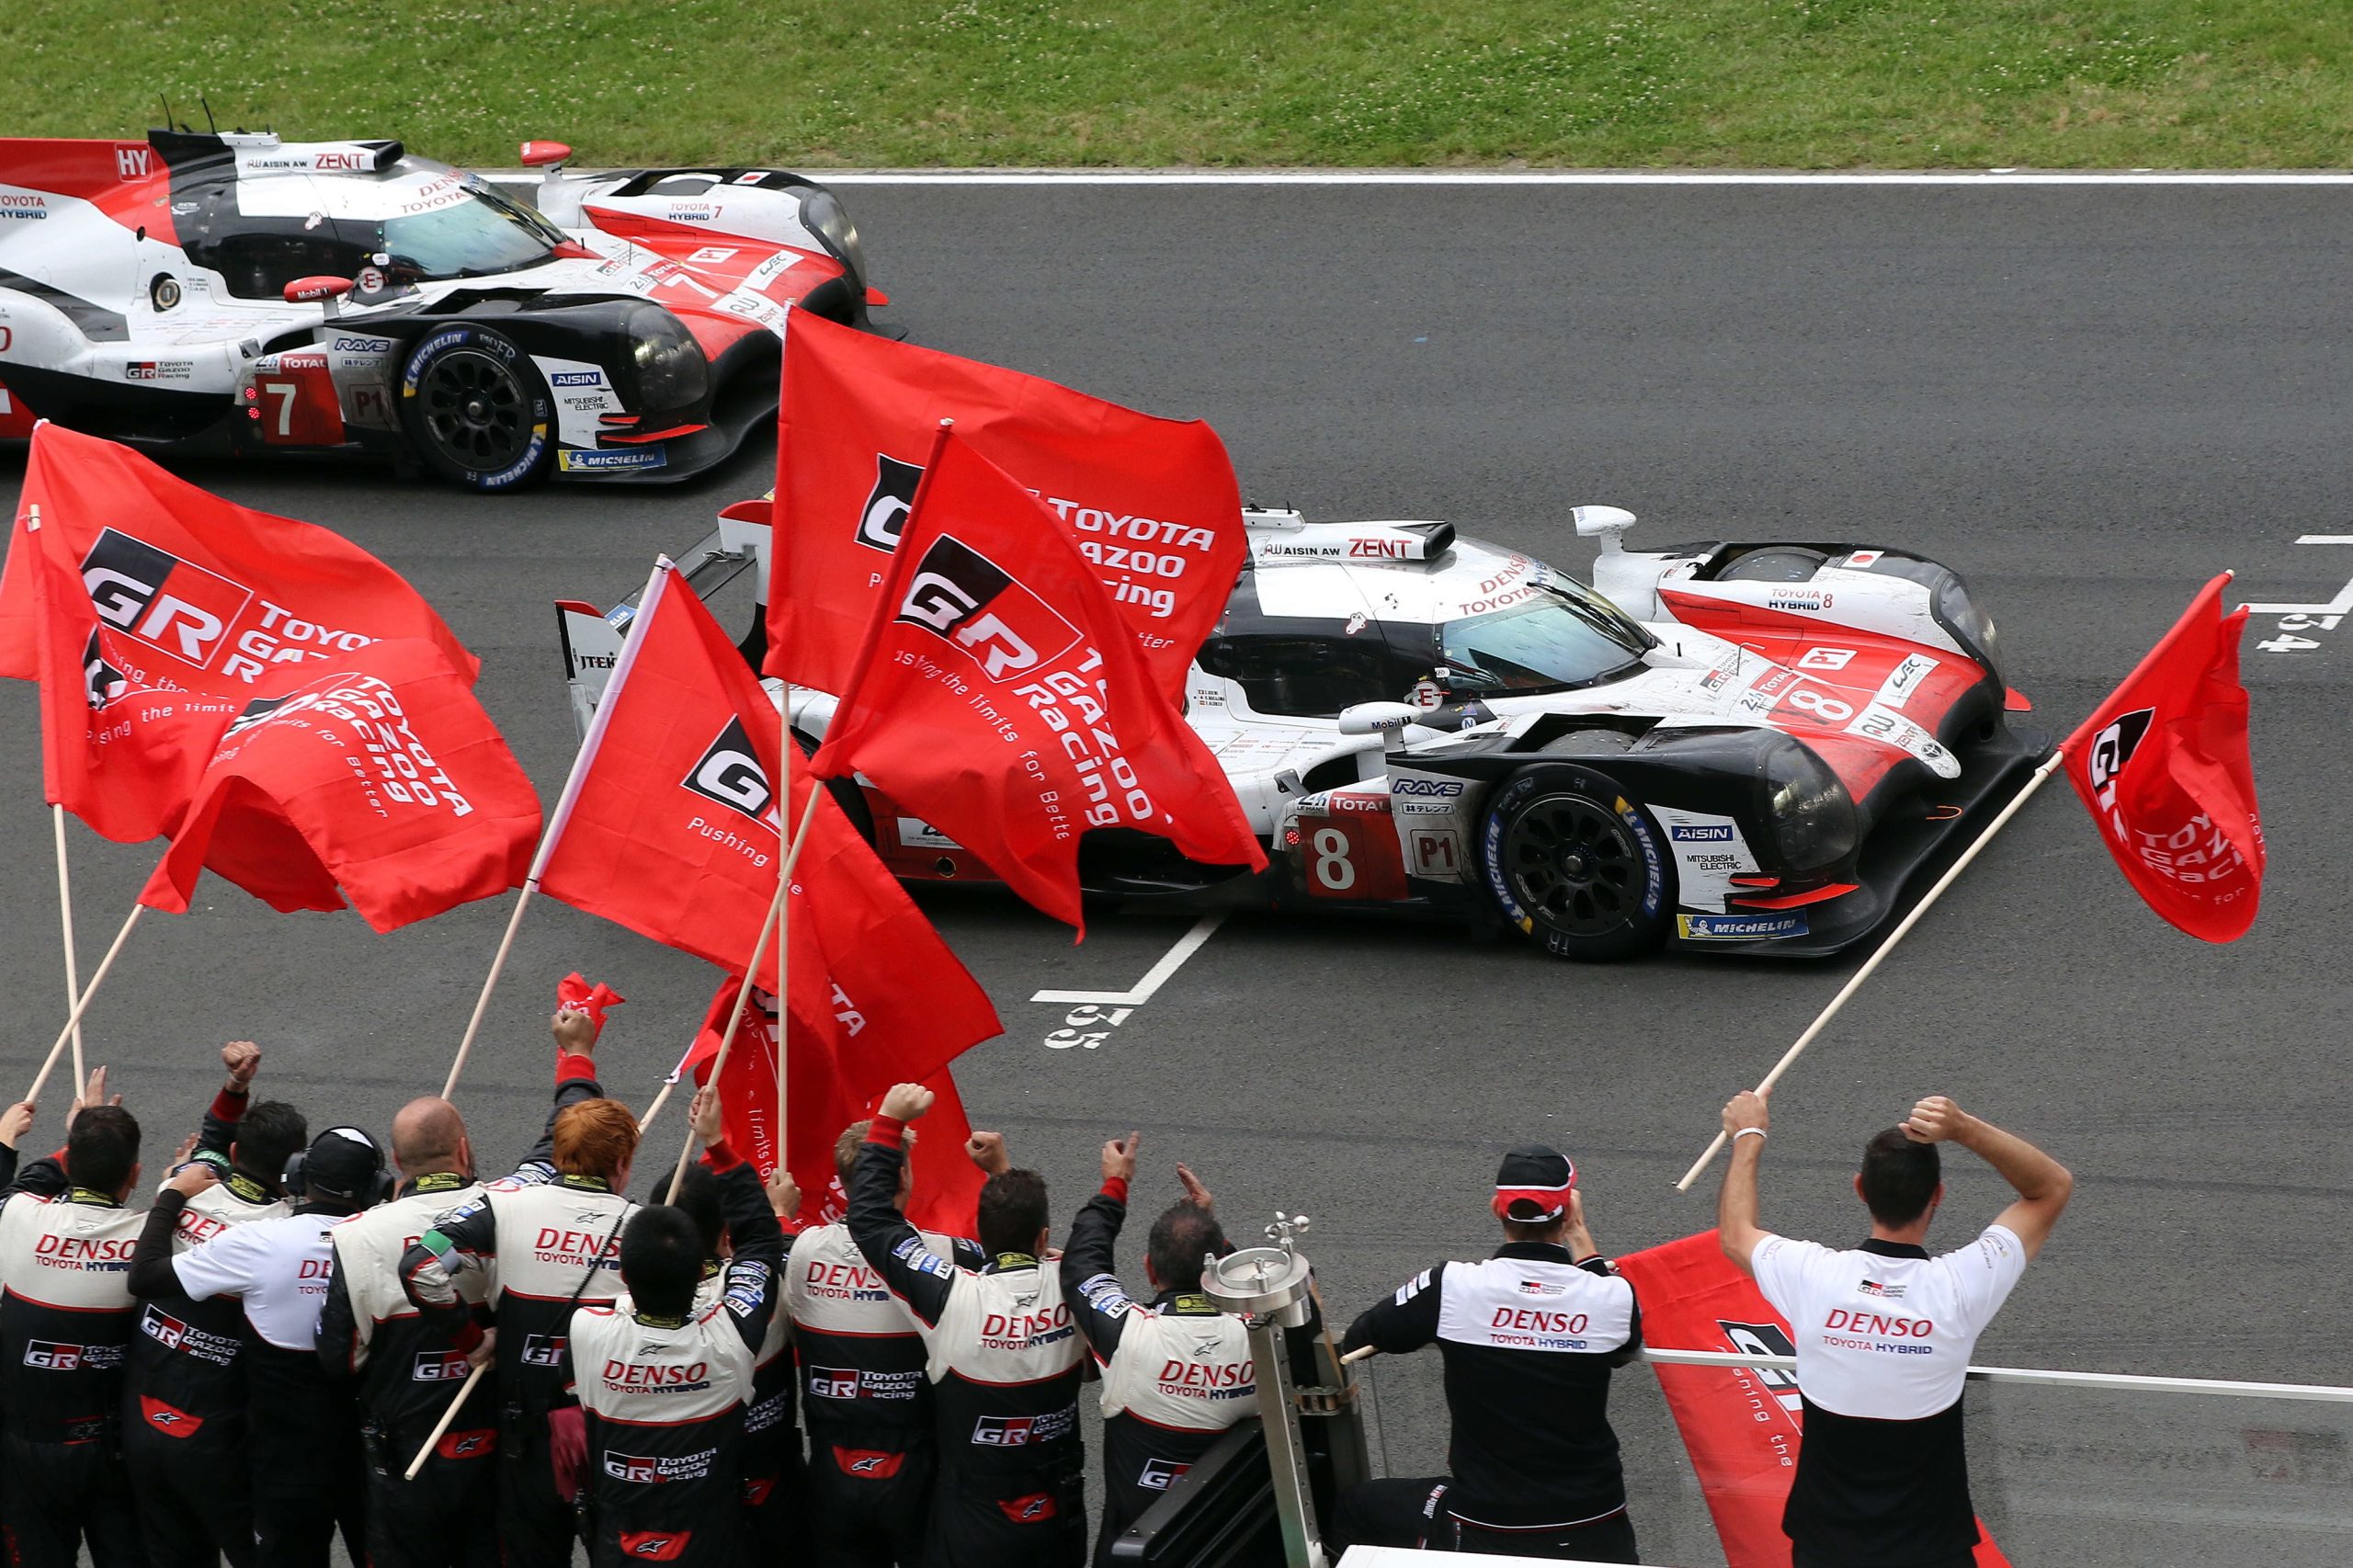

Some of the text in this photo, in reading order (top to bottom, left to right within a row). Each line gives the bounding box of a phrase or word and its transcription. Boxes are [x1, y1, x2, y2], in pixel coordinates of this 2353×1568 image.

[118, 149, 148, 176] HY
[262, 160, 290, 168] AISIN
[292, 160, 308, 168] AW
[314, 153, 365, 170] ZENT
[670, 203, 723, 219] TOYOTA 7
[648, 262, 676, 278] TOTAL
[664, 273, 719, 300] 7
[335, 337, 391, 352] RAYS
[127, 368, 155, 379] GR
[282, 357, 327, 369] TOTAL
[555, 374, 598, 385] AISIN
[265, 383, 297, 436] 7
[355, 391, 384, 417] P1
[563, 396, 604, 405] MITSUBISHI
[574, 403, 609, 411] ELECTRIC
[587, 452, 655, 466] MICHELIN
[1047, 497, 1215, 551] TOYOTA
[1077, 540, 1187, 579] AZOO
[1283, 547, 1318, 556] AISIN
[1321, 548, 1341, 556] AW
[1348, 538, 1413, 560] ZENT
[1104, 574, 1176, 619] ing
[1459, 585, 1537, 616] TOYOTA
[1768, 599, 1820, 611] HYBRID
[1772, 588, 1834, 609] TOYOTA 8
[81, 566, 223, 661] GR
[259, 599, 384, 653] TOYO
[899, 571, 1040, 678] GR
[580, 655, 619, 670] JTEK
[1806, 649, 1847, 665] P1
[1707, 672, 1731, 692] GR
[1759, 666, 1792, 693] TOTAL
[1418, 688, 1435, 706] E
[1788, 689, 1855, 722] 8
[142, 703, 235, 722] the limit
[940, 671, 969, 696] the
[968, 693, 1020, 743] limits
[1019, 749, 1046, 782] for
[1371, 718, 1401, 730] Mobil
[1464, 719, 1473, 729] N
[310, 699, 415, 804] Racing
[325, 687, 439, 807] GAZOO
[356, 676, 474, 817] TOYOTA
[1012, 683, 1120, 827] Racing
[1043, 671, 1154, 820] GAZOO
[315, 729, 389, 818] for Better
[1392, 778, 1464, 797] RAYS
[1333, 797, 1391, 812] TOTAL
[687, 816, 769, 867] Pushing
[1677, 827, 1728, 839] AISIN
[1313, 827, 1356, 891] 8
[1418, 836, 1454, 869] P1
[1486, 820, 1514, 905] MICHELIN
[1687, 854, 1735, 863] MITSUBISHI
[1632, 827, 1661, 912] MICHELIN
[1699, 861, 1742, 870] ELECTRIC
[1713, 919, 1795, 934] MICHELIN
[747, 1108, 770, 1160] limits
[34, 1233, 138, 1261] DENSO
[535, 1227, 623, 1258] DENS
[34, 1255, 84, 1271] TOYOTA
[533, 1251, 585, 1267] TOYOTA
[806, 1260, 881, 1290] DENS
[806, 1285, 850, 1300] TOYOTA
[1858, 1285, 1883, 1297] GR
[982, 1301, 1071, 1339] DENSO
[1491, 1308, 1588, 1335] DENSO
[1824, 1308, 1934, 1338] DENSO
[142, 1316, 181, 1347] GR
[1490, 1334, 1587, 1350] TOYOTA HYBRID
[181, 1335, 238, 1358] GAZOO
[1823, 1335, 1933, 1356] TOYOTA HYBRID
[27, 1350, 79, 1369] GR
[415, 1360, 469, 1380] GR
[602, 1358, 707, 1385] DENSO
[1158, 1359, 1255, 1388] DENSO
[602, 1380, 652, 1394] TOYOTA
[811, 1370, 923, 1397] GR TOYOTA
[860, 1381, 917, 1390] GAZOO
[1158, 1382, 1207, 1399] TOYOTA
[974, 1427, 1029, 1445] GR
[1769, 1434, 1793, 1467] the
[606, 1447, 717, 1482] GR TOYOTA
[656, 1458, 710, 1475] GAZOO
